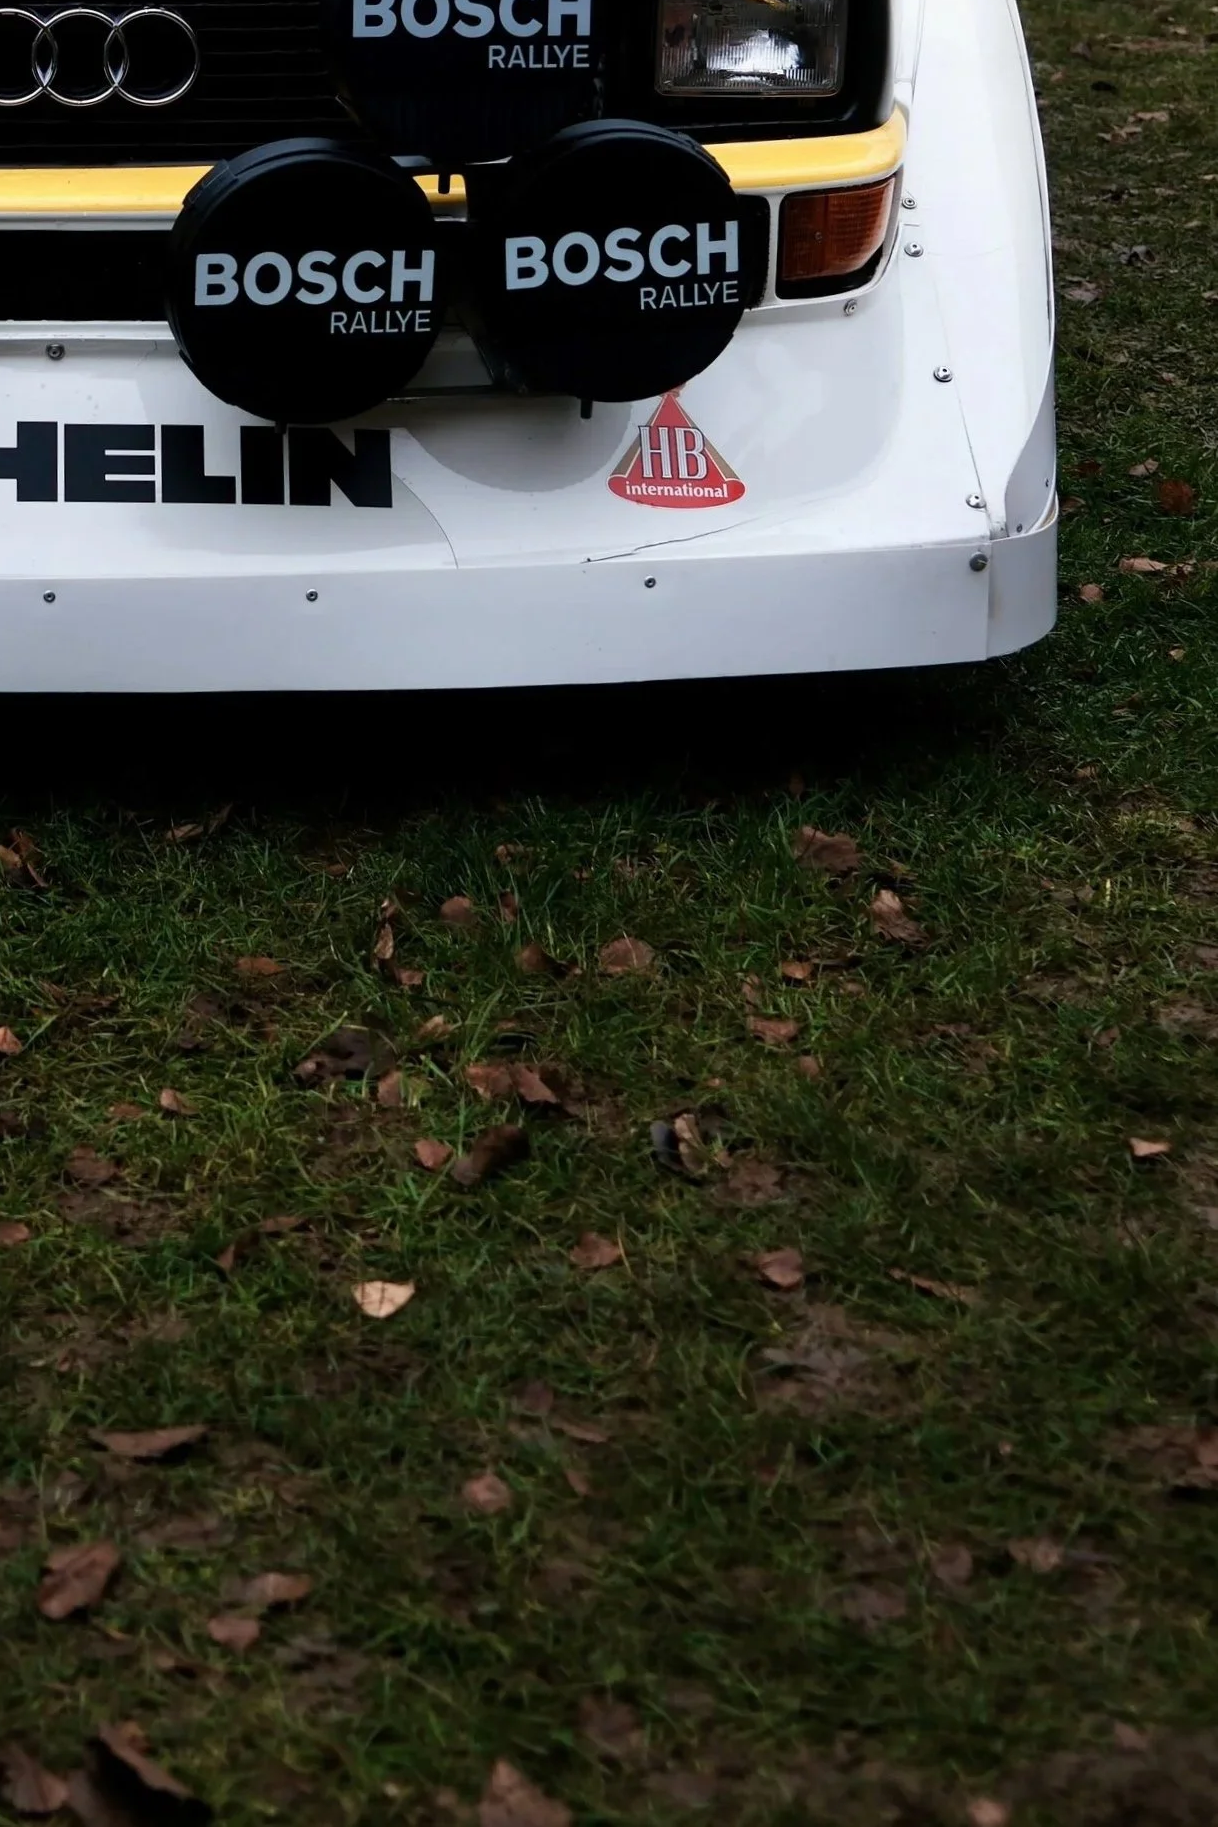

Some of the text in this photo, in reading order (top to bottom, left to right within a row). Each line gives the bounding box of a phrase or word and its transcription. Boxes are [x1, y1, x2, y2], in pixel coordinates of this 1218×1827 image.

[488, 45, 589, 69] RALLYE
[506, 220, 739, 290] BOSCH
[194, 250, 435, 305] BOSCH
[639, 280, 741, 311] RALLYE
[330, 310, 431, 334] RALLYE
[639, 426, 709, 480] HB
[626, 481, 729, 498] international
